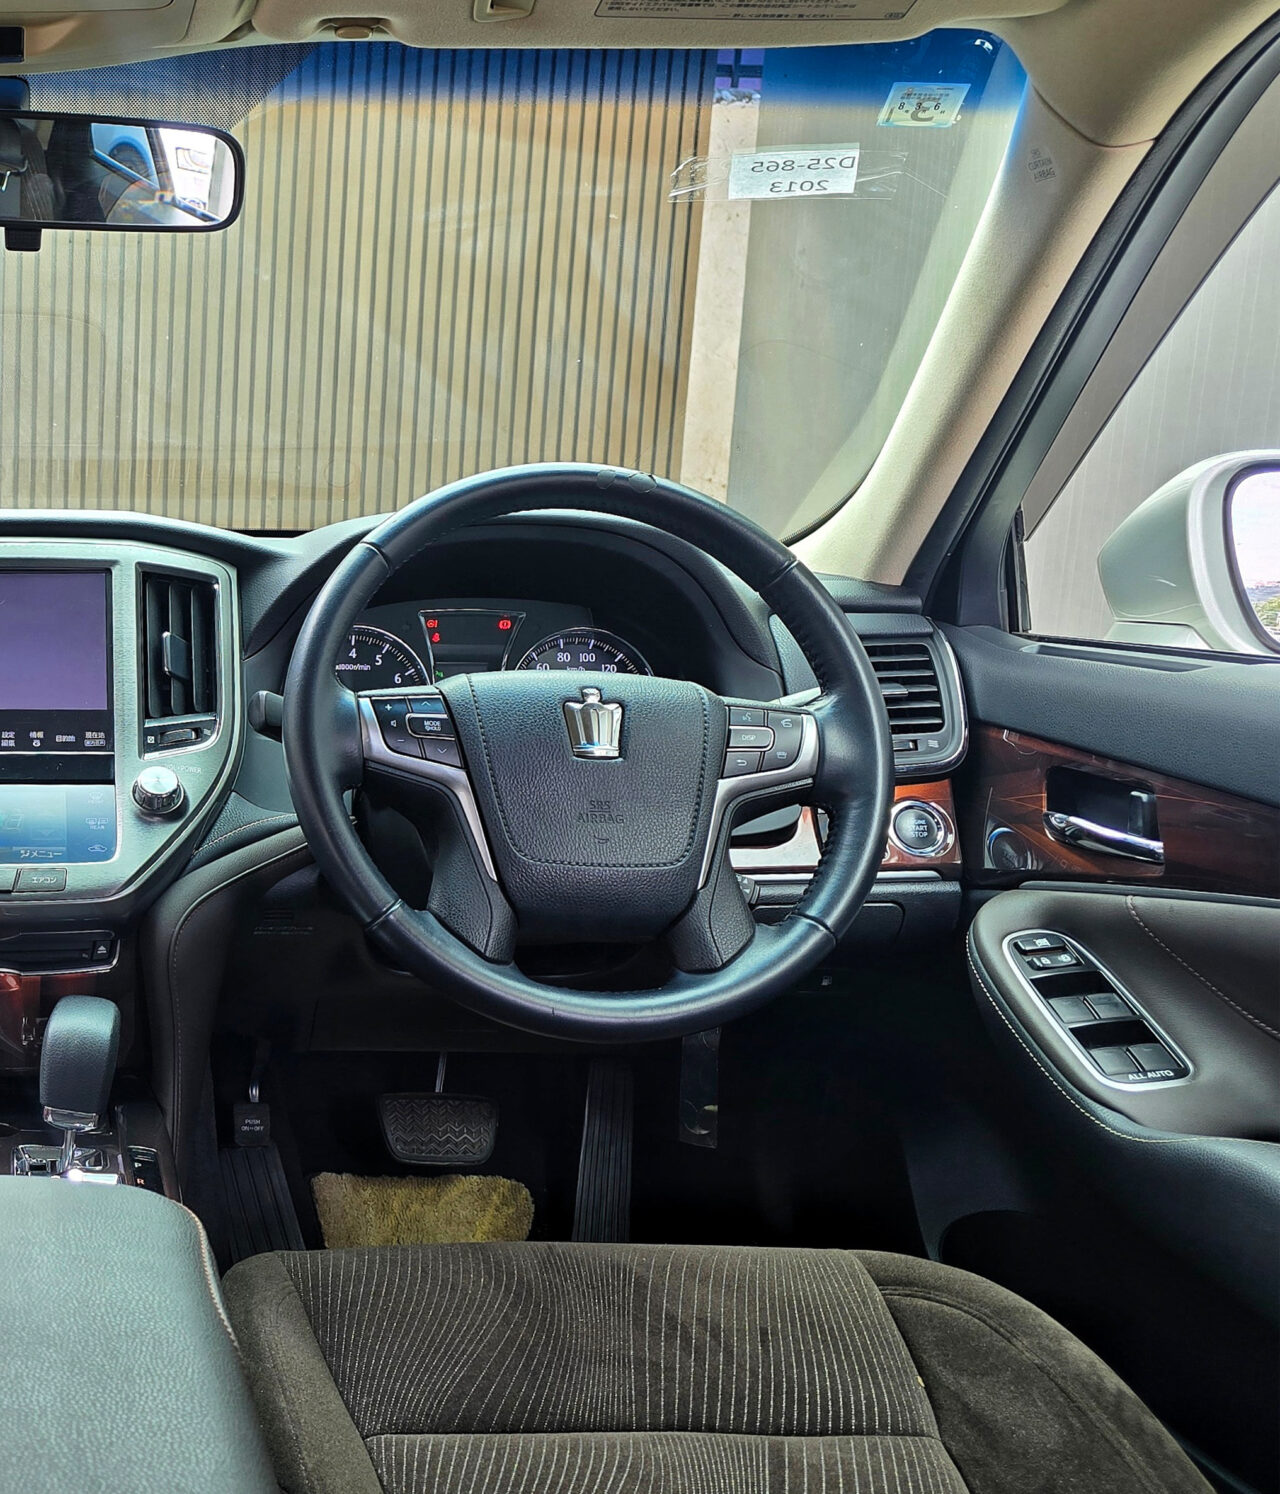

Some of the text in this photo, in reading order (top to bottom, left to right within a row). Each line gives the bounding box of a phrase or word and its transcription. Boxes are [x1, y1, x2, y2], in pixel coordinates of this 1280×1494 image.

[348, 648, 357, 659] 4
[557, 652, 571, 662] 80
[579, 653, 596, 662] 100
[375, 654, 383, 666] 5
[536, 663, 550, 671] 60
[601, 664, 617, 673] 120
[394, 673, 402, 684] 6
[590, 800, 611, 809] SRS
[578, 813, 624, 824] AIRBAG
[31, 850, 63, 858] メニュー
[32, 876, 57, 884] エアコン
[1128, 1070, 1175, 1081] ALL AUTO
